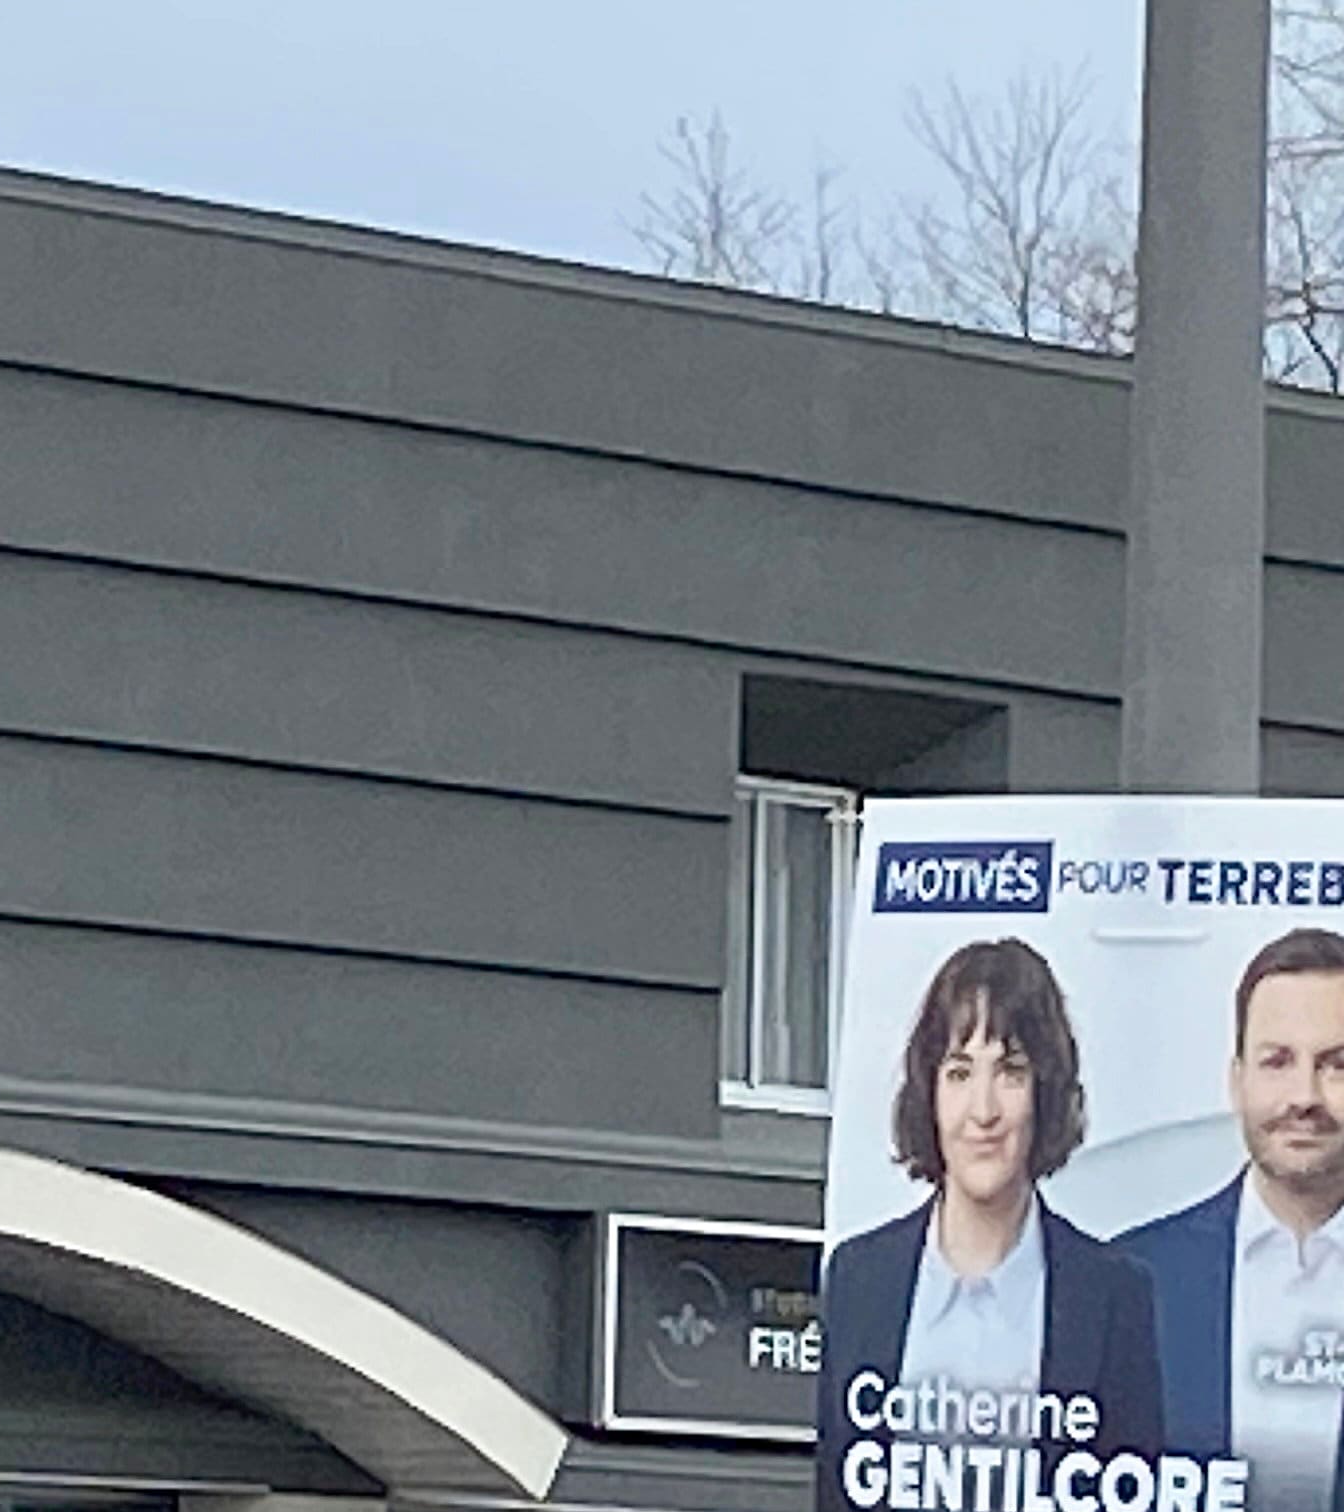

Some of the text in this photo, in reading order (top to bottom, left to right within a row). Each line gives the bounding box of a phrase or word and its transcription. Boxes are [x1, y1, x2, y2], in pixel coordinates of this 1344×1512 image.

[885, 849, 1040, 902] MOTIVÉS
[1059, 860, 1150, 894] POUR
[846, 1370, 1099, 1442] Catherine
